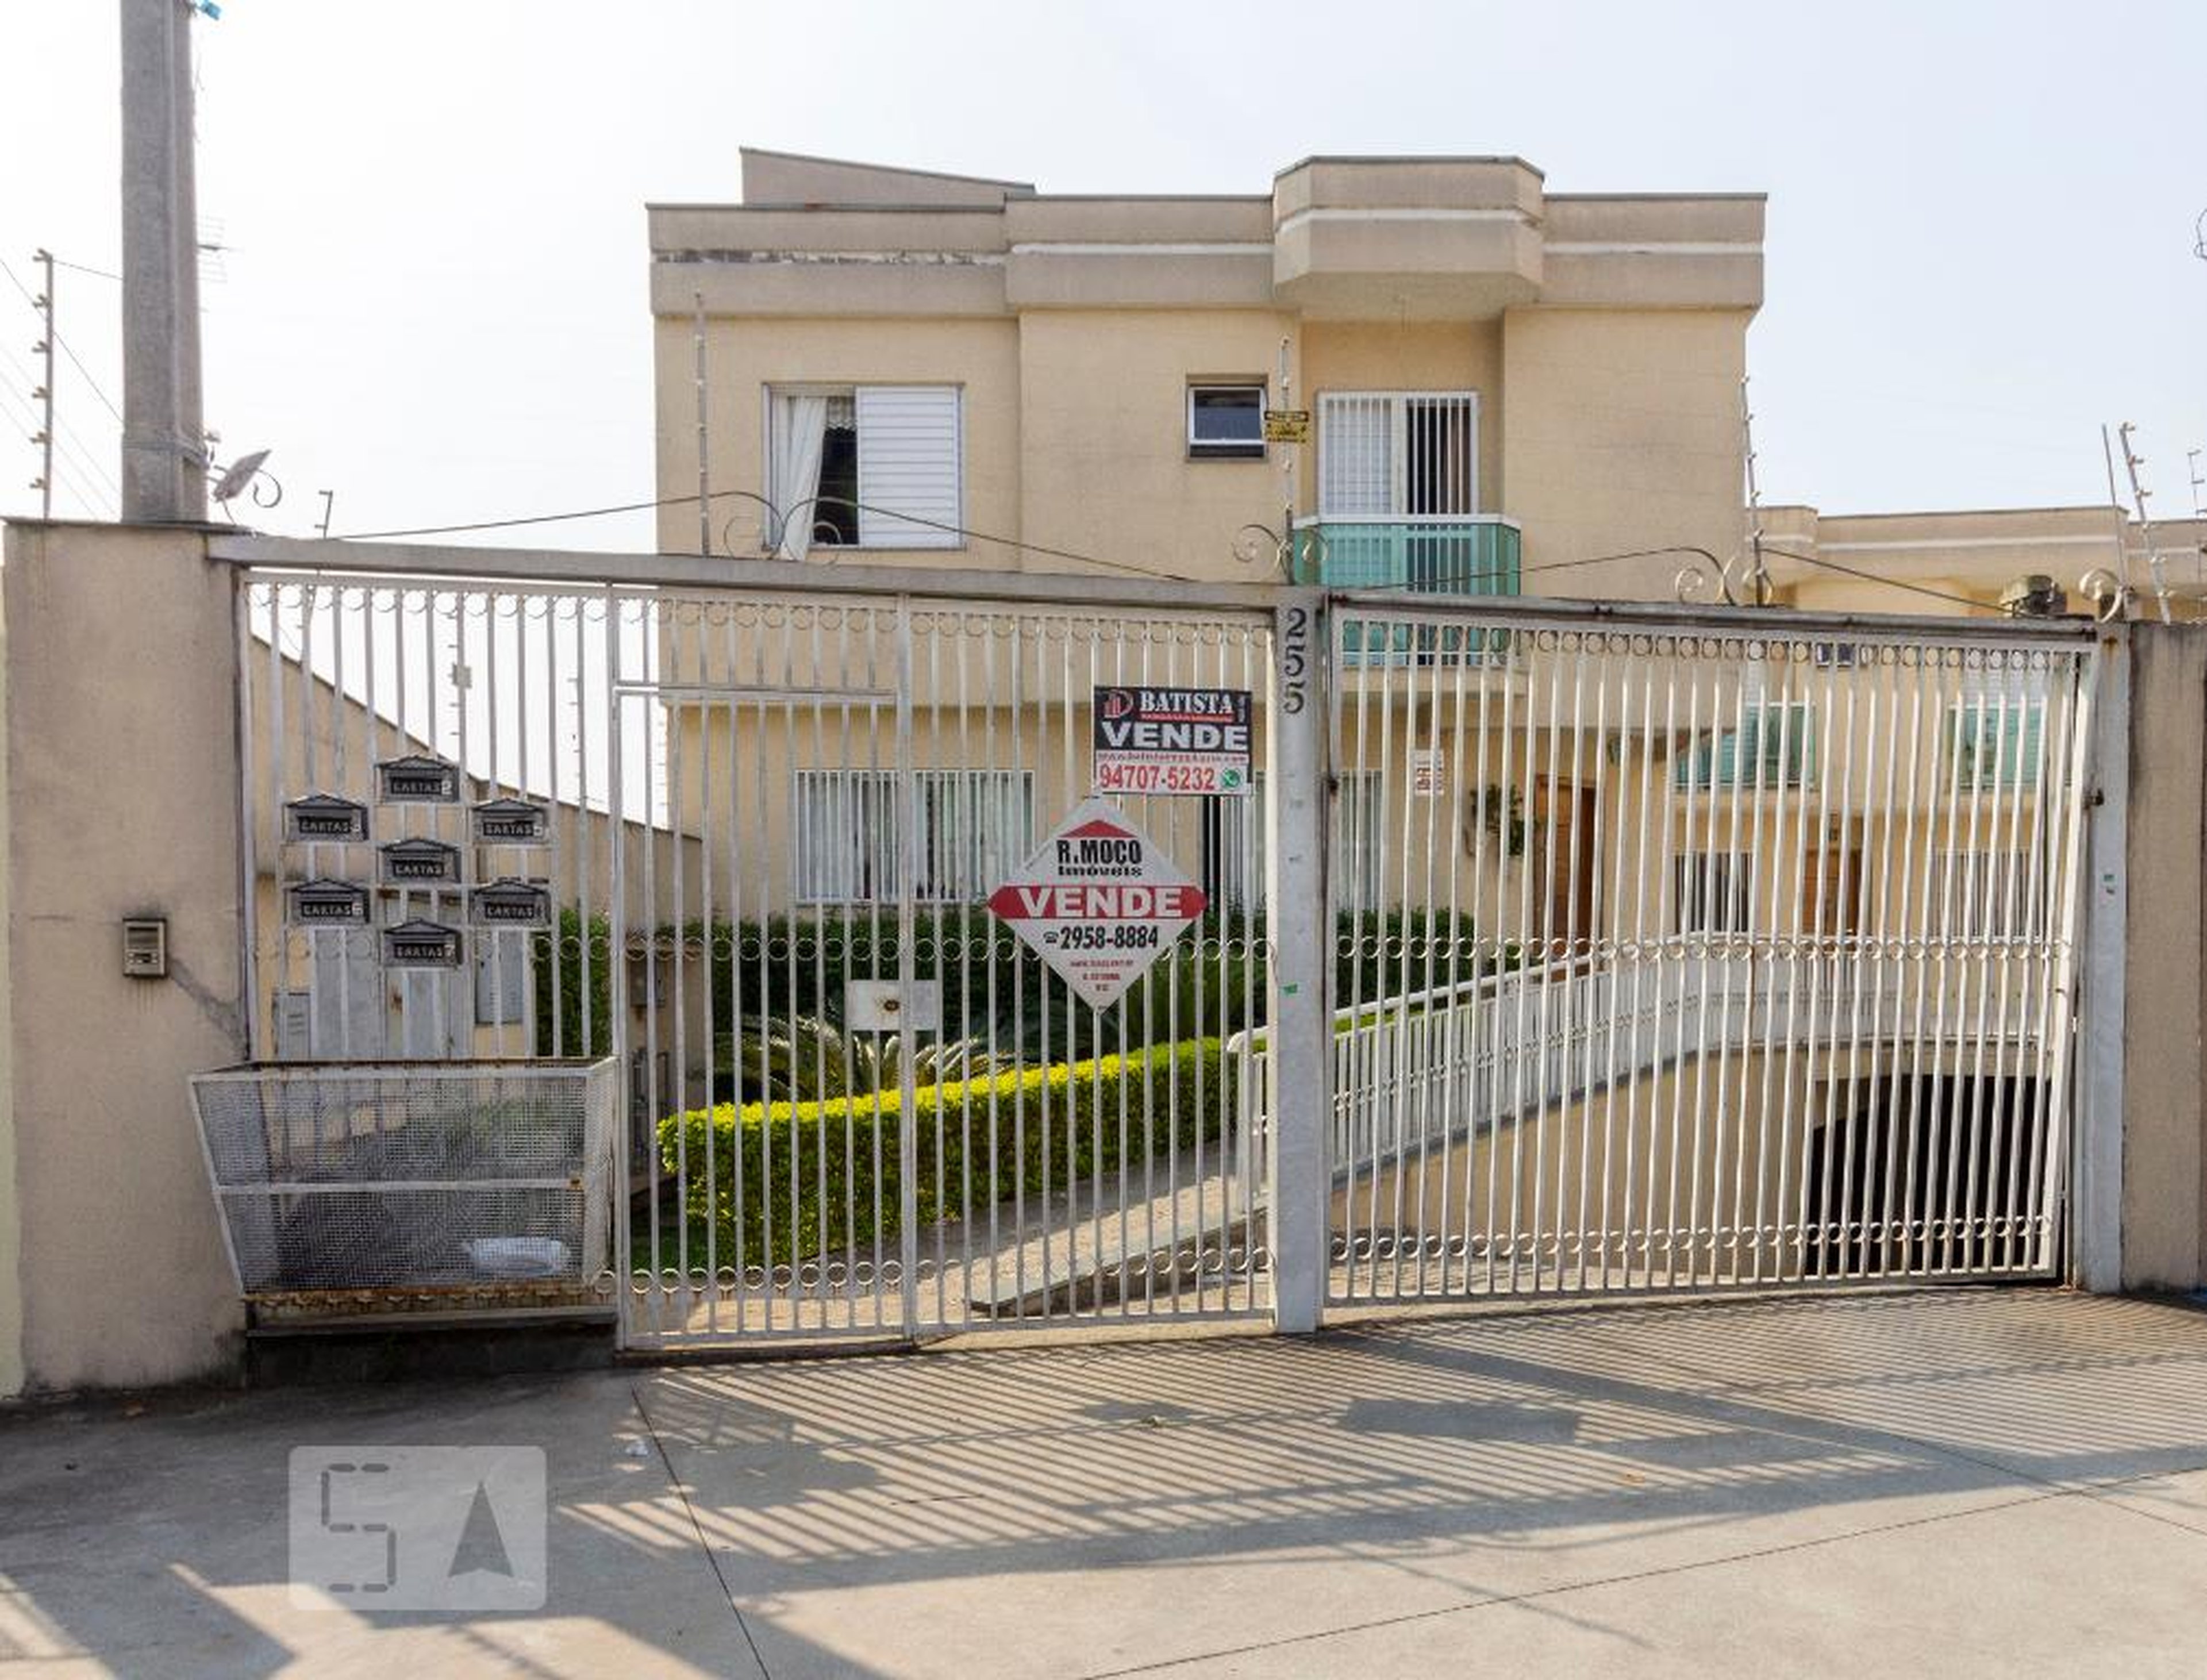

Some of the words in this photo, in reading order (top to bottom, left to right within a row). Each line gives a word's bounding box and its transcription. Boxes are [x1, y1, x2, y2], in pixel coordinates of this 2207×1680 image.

[1284, 608, 1306, 714] 255
[1139, 691, 1233, 714] BATISTA
[1101, 721, 1248, 751] VENDE
[1017, 887, 1182, 917] VENDE
[1060, 926, 1159, 949] 2958-8884
